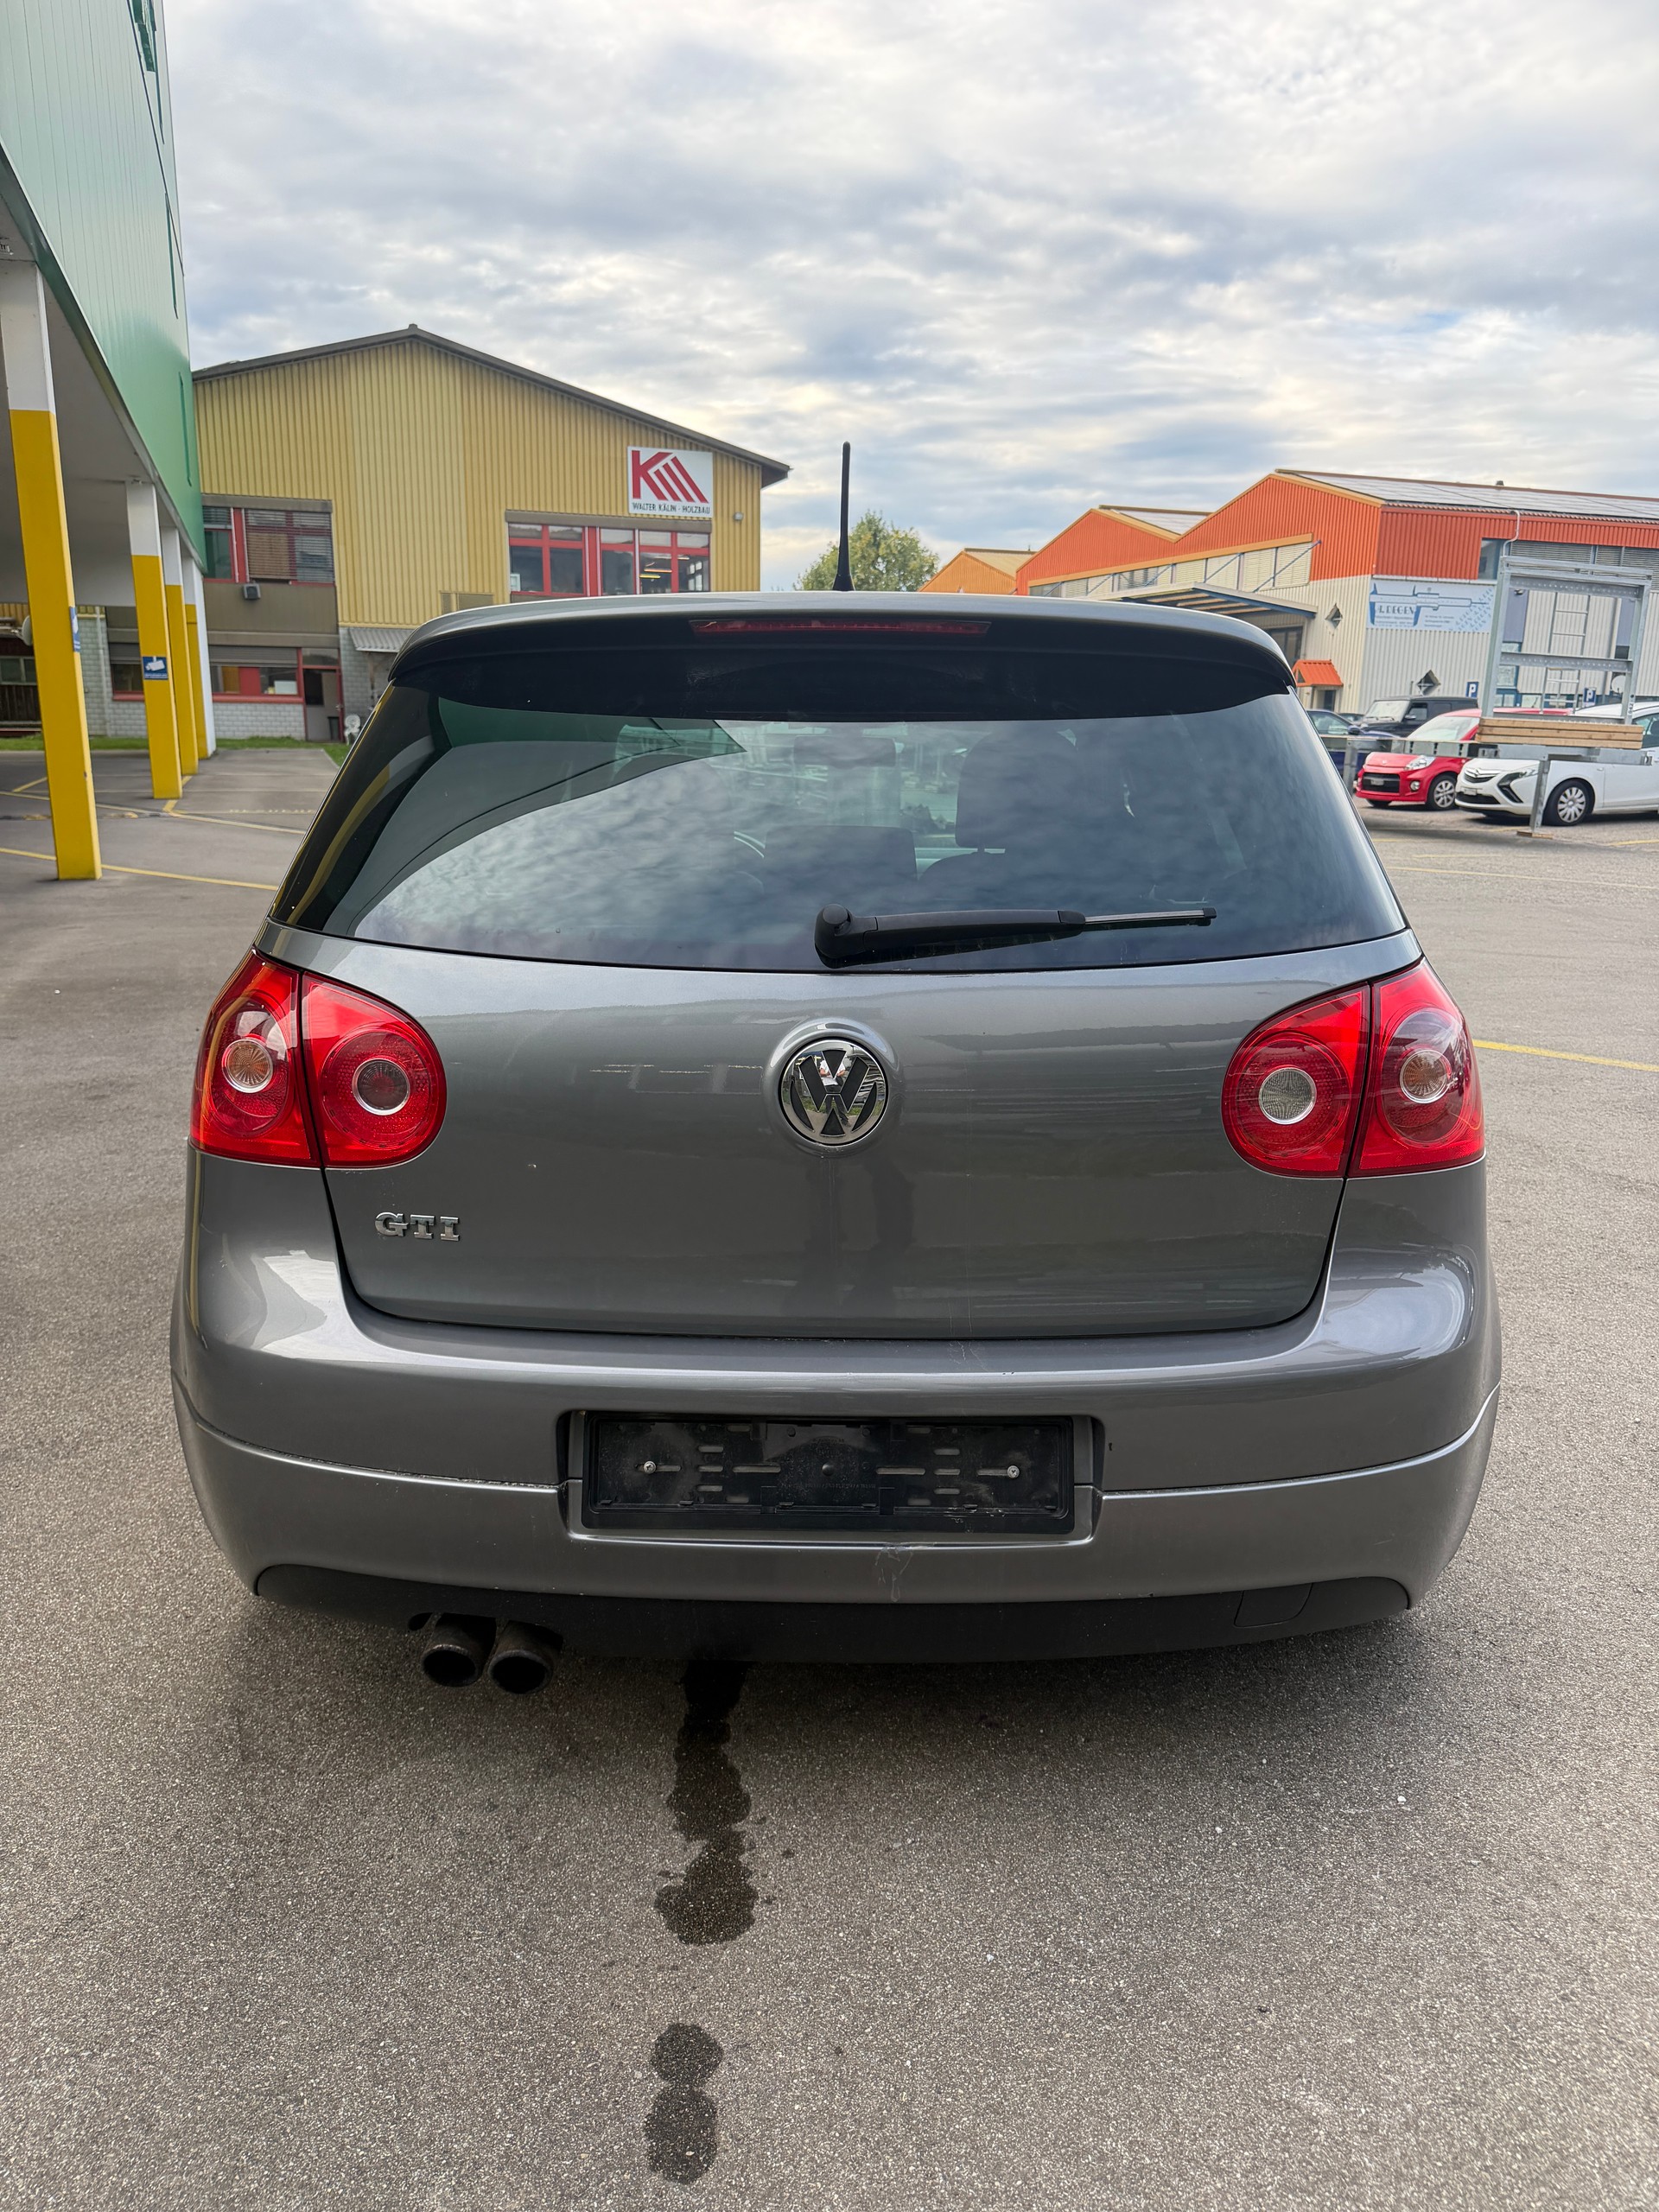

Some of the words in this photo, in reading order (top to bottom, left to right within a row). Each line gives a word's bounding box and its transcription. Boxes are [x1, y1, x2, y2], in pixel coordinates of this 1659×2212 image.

[632, 502, 656, 512] WALTER
[682, 505, 710, 514] HOLZBAU
[1469, 683, 1477, 697] P
[374, 1211, 460, 1242] GTI
